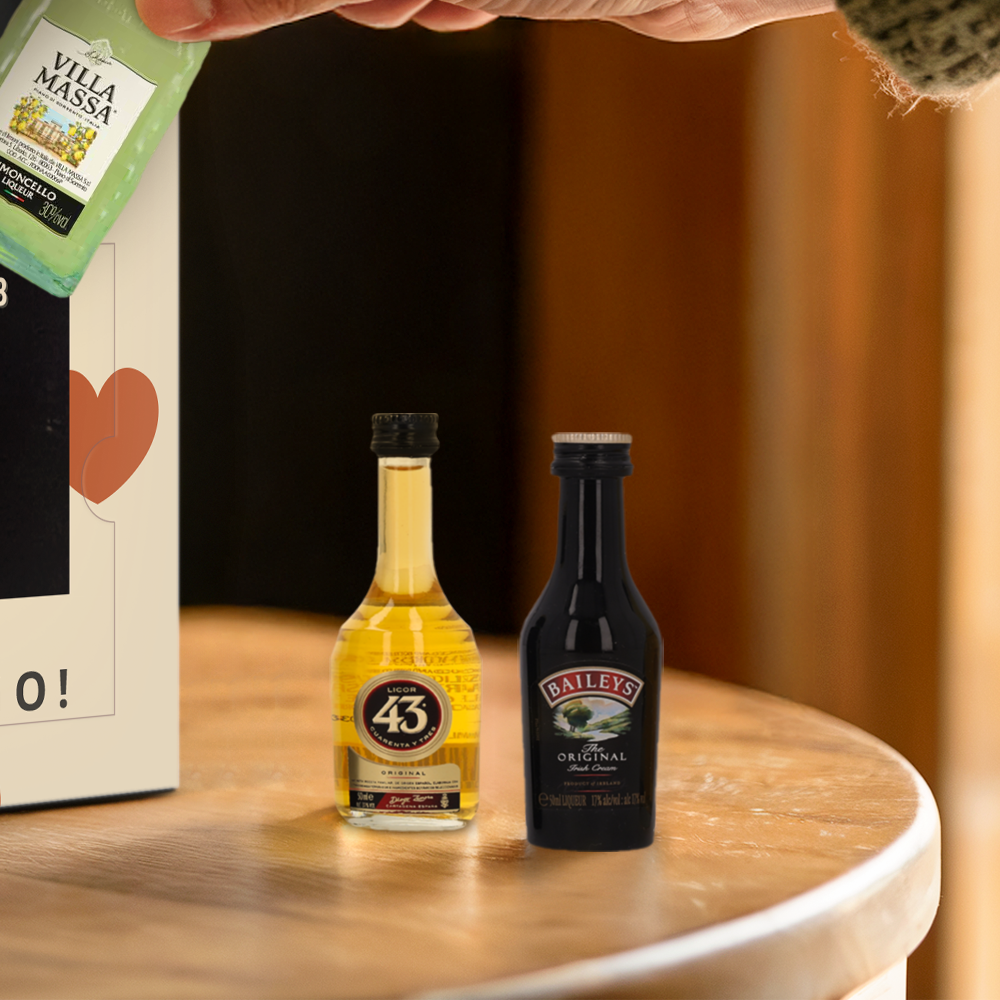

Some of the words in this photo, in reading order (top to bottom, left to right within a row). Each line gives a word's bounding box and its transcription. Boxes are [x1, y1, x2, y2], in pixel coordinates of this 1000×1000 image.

[54, 51, 116, 104] VILLA
[33, 66, 111, 125] MASSA
[1, 177, 35, 200] LIQUEUR
[548, 673, 634, 697] BAILEYS
[372, 695, 428, 734] 43
[369, 726, 410, 748] CUARENTA
[419, 726, 437, 743] TRES
[581, 743, 605, 753] The
[557, 752, 627, 762] ORIGINAL
[567, 764, 590, 772] Irish
[591, 764, 618, 772] Cream
